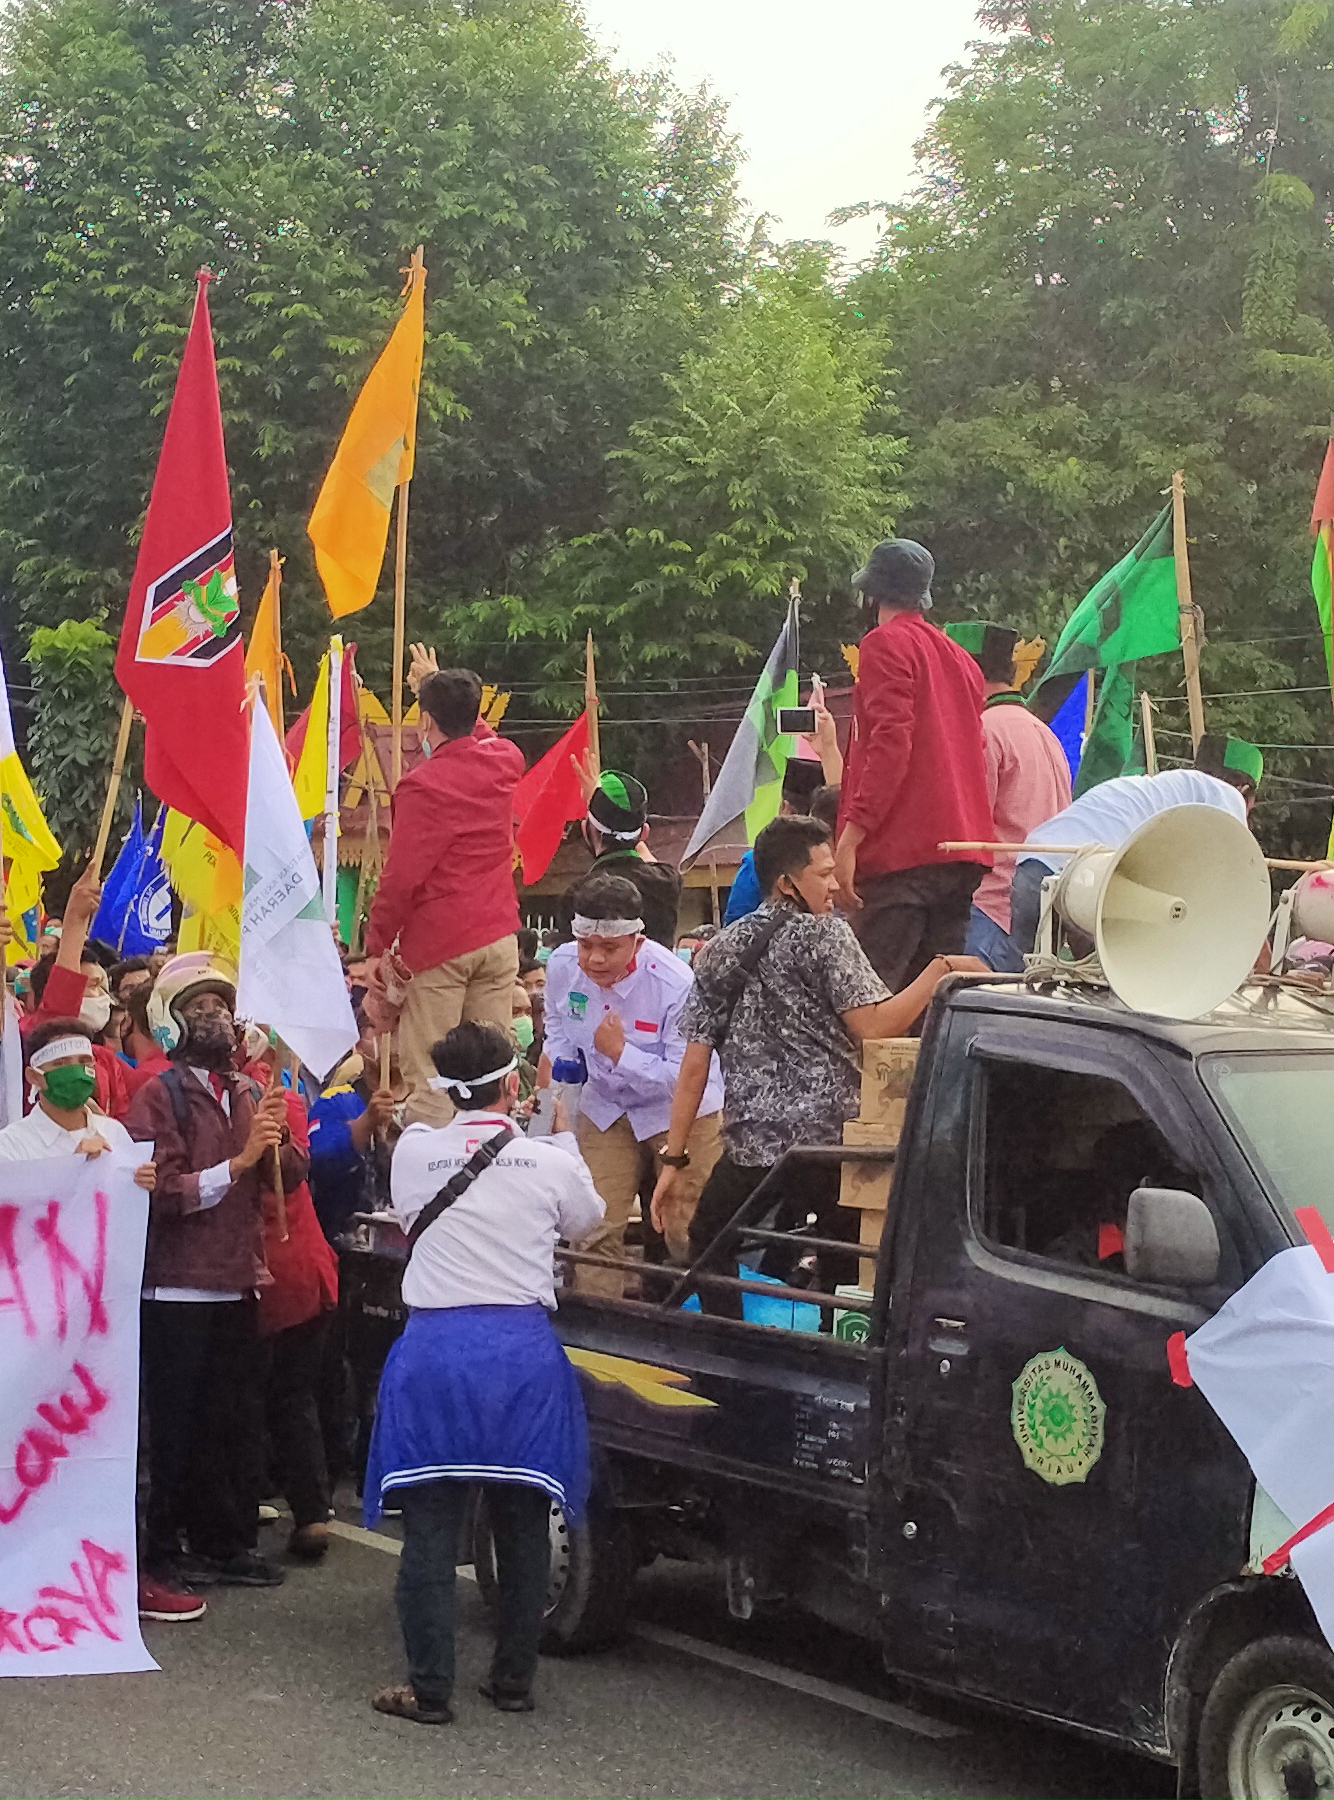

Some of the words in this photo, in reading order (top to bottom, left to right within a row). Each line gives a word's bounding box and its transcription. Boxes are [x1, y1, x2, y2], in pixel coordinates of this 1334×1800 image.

[1016, 1359, 1052, 1445] UNIVERSITAS
[1053, 1357, 1100, 1460] MUHAMMADIYAH
[1036, 1455, 1075, 1476] RIAU
